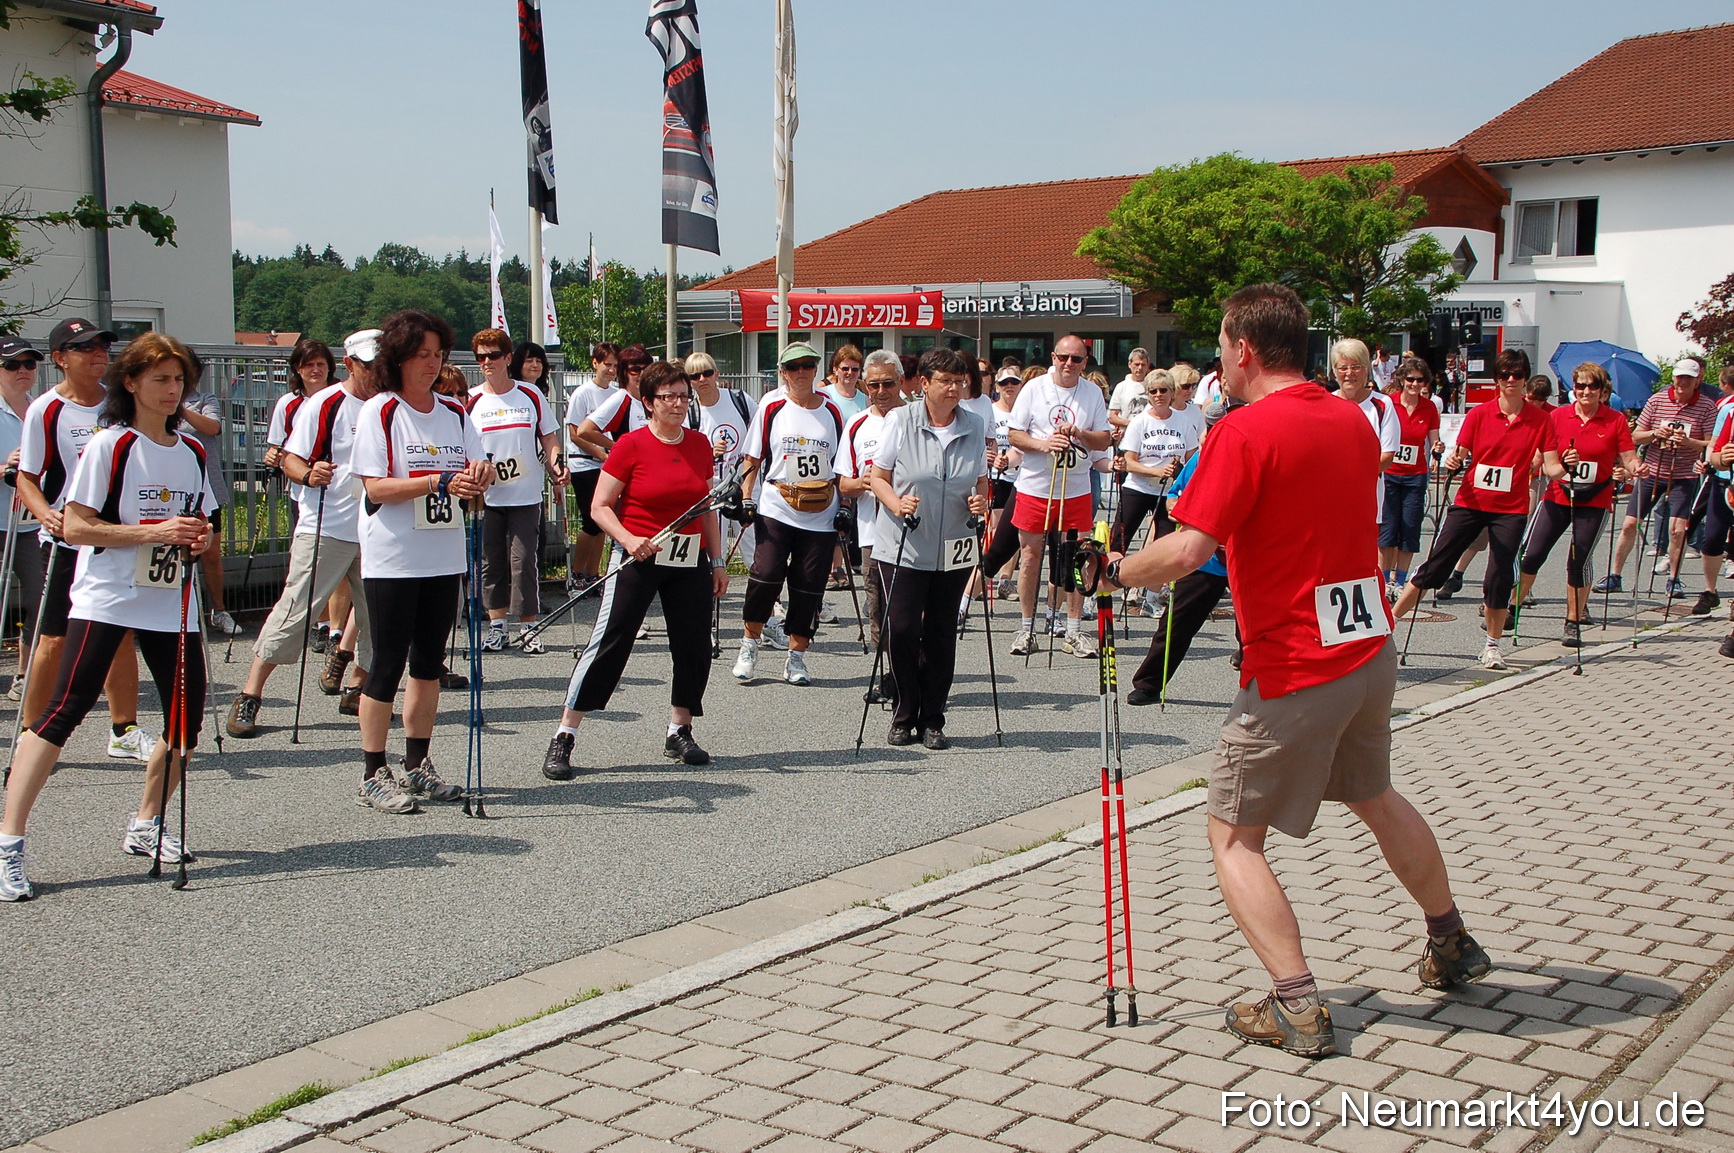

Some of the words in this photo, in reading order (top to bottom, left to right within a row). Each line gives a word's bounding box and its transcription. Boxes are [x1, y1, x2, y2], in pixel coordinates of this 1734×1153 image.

[1026, 291, 1083, 316] Jänig
[1144, 428, 1182, 440] BERGER
[1142, 443, 1166, 451] POWER
[1394, 446, 1412, 462] 43
[495, 458, 520, 481] 62
[797, 454, 820, 478] 53
[1482, 467, 1502, 487] 41
[425, 492, 453, 524] 63
[668, 535, 691, 562] 14
[952, 537, 974, 565] 22
[148, 545, 180, 584] 56
[1329, 583, 1374, 635] 24
